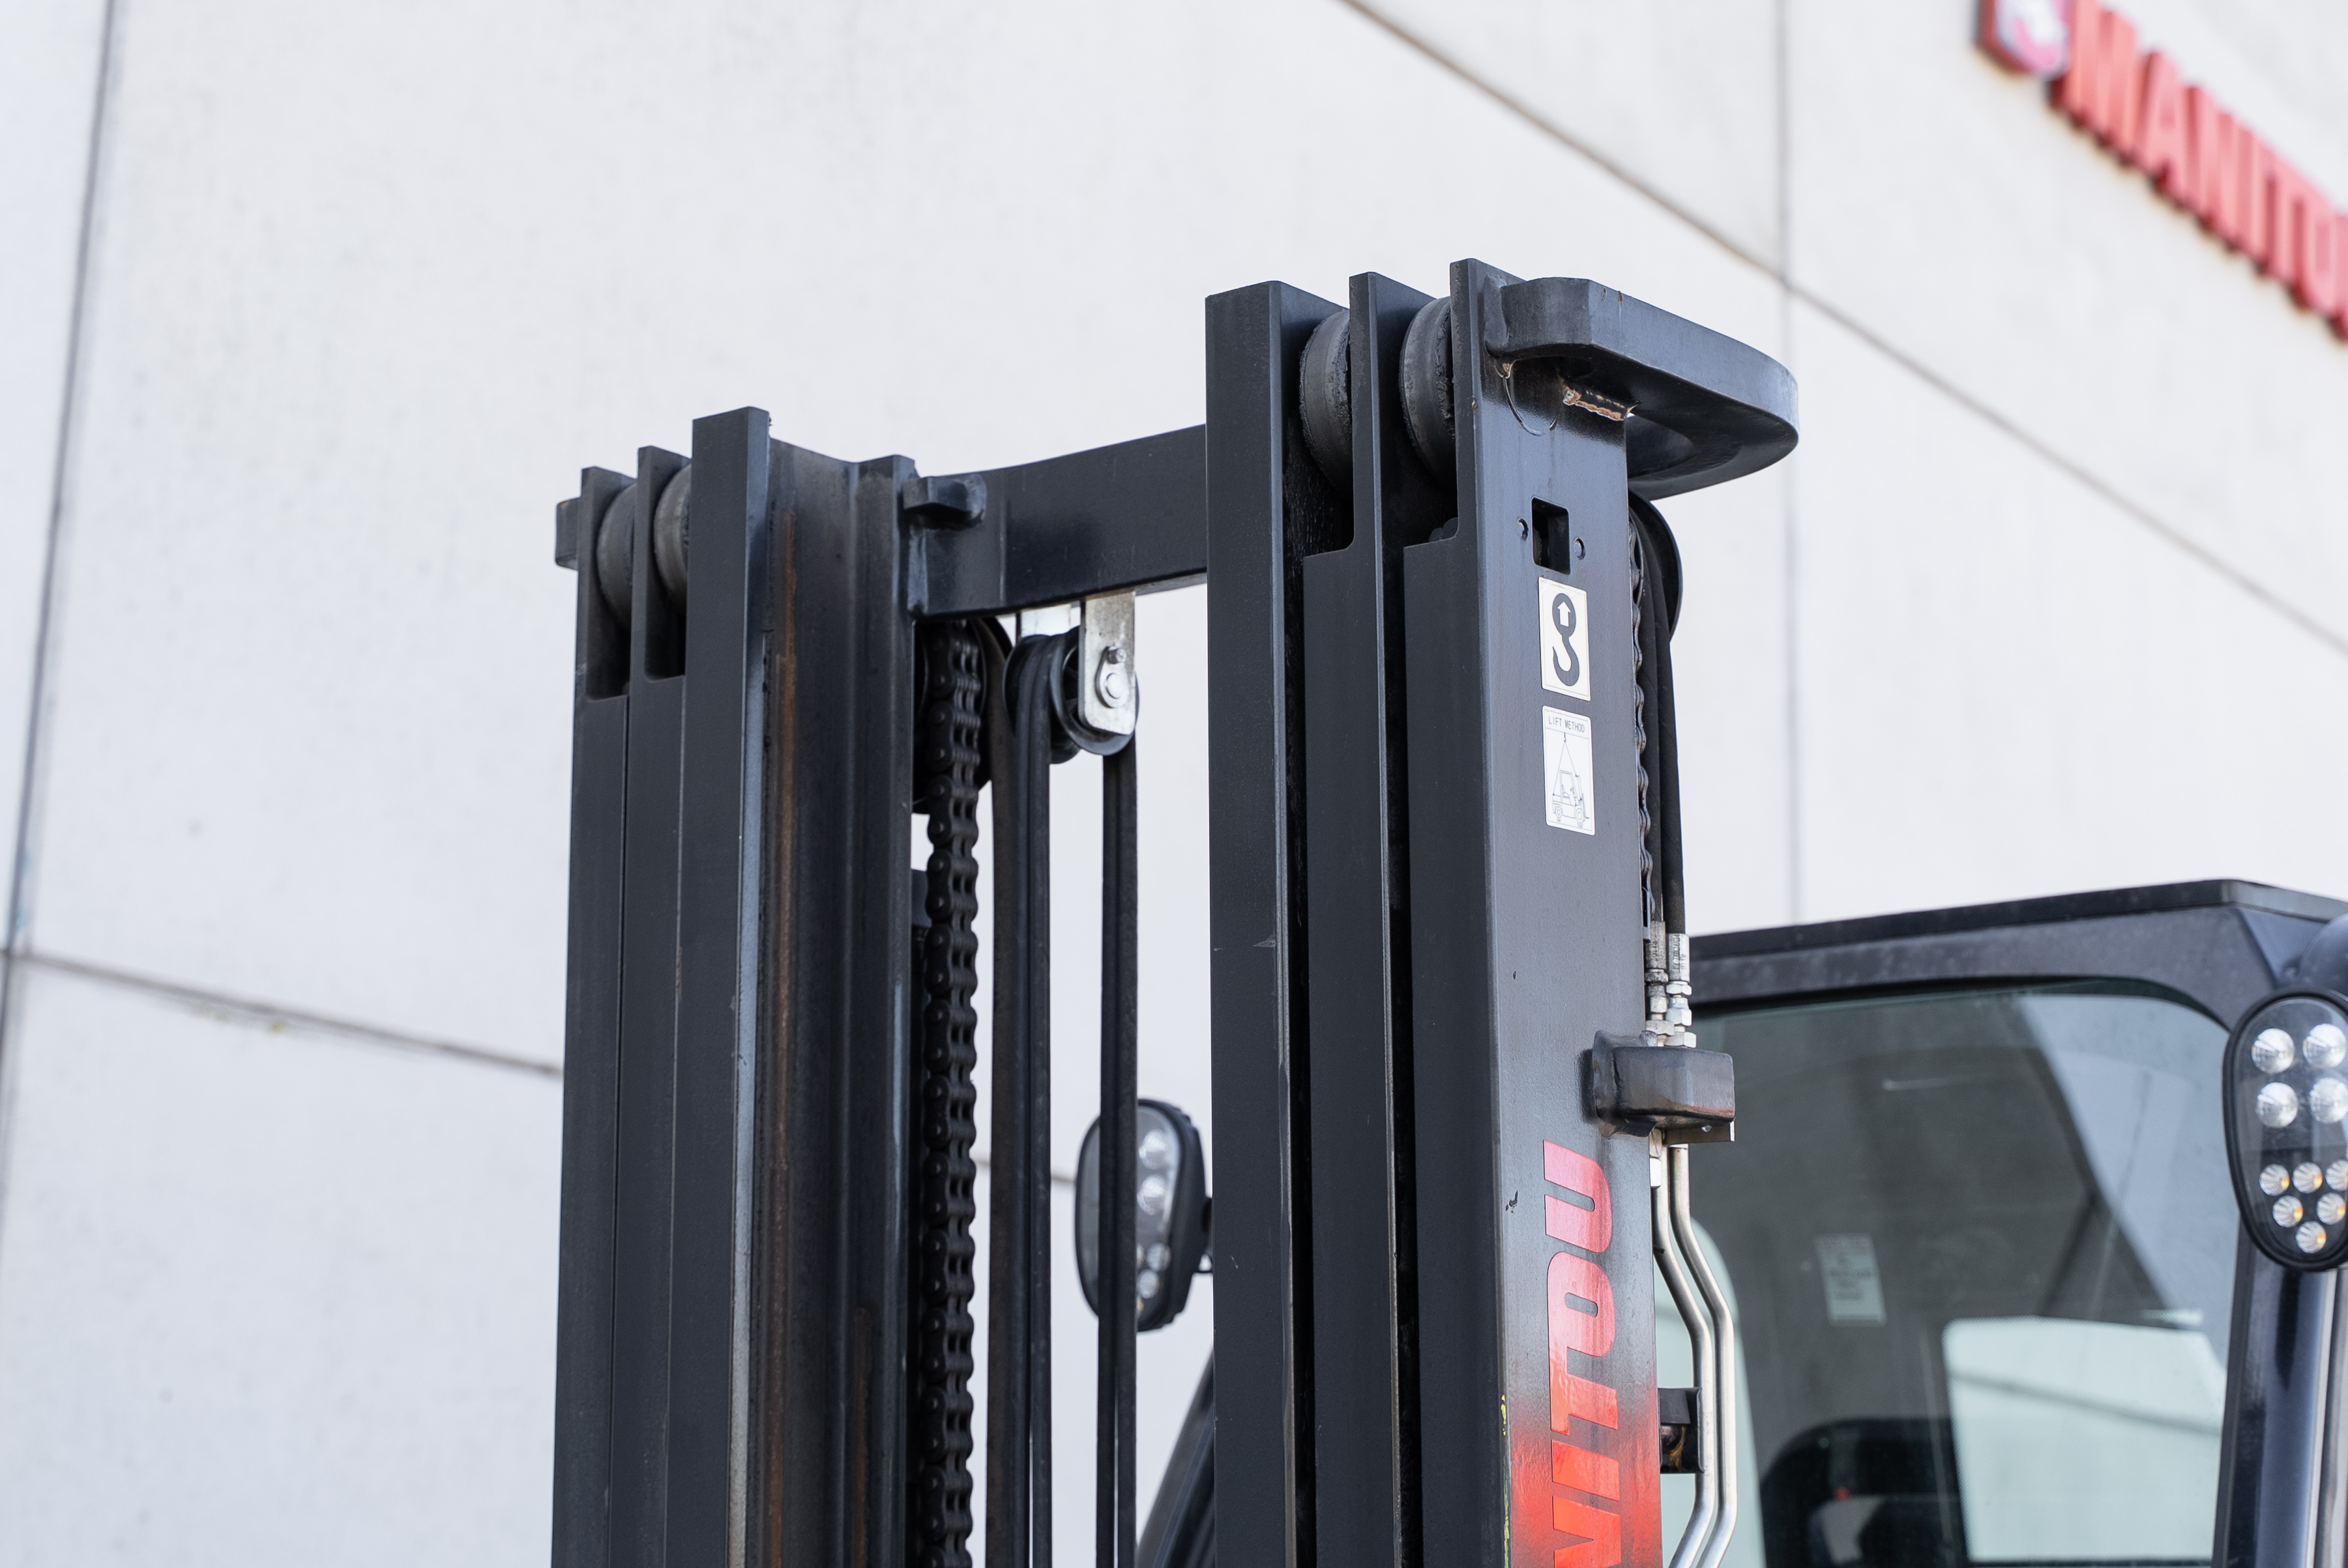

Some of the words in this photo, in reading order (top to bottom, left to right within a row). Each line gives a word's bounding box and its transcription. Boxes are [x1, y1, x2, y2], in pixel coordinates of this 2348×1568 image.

[2053, 0, 2348, 334] MANITO
[1548, 715, 1562, 727] LIFT
[1564, 719, 1585, 733] METHOD
